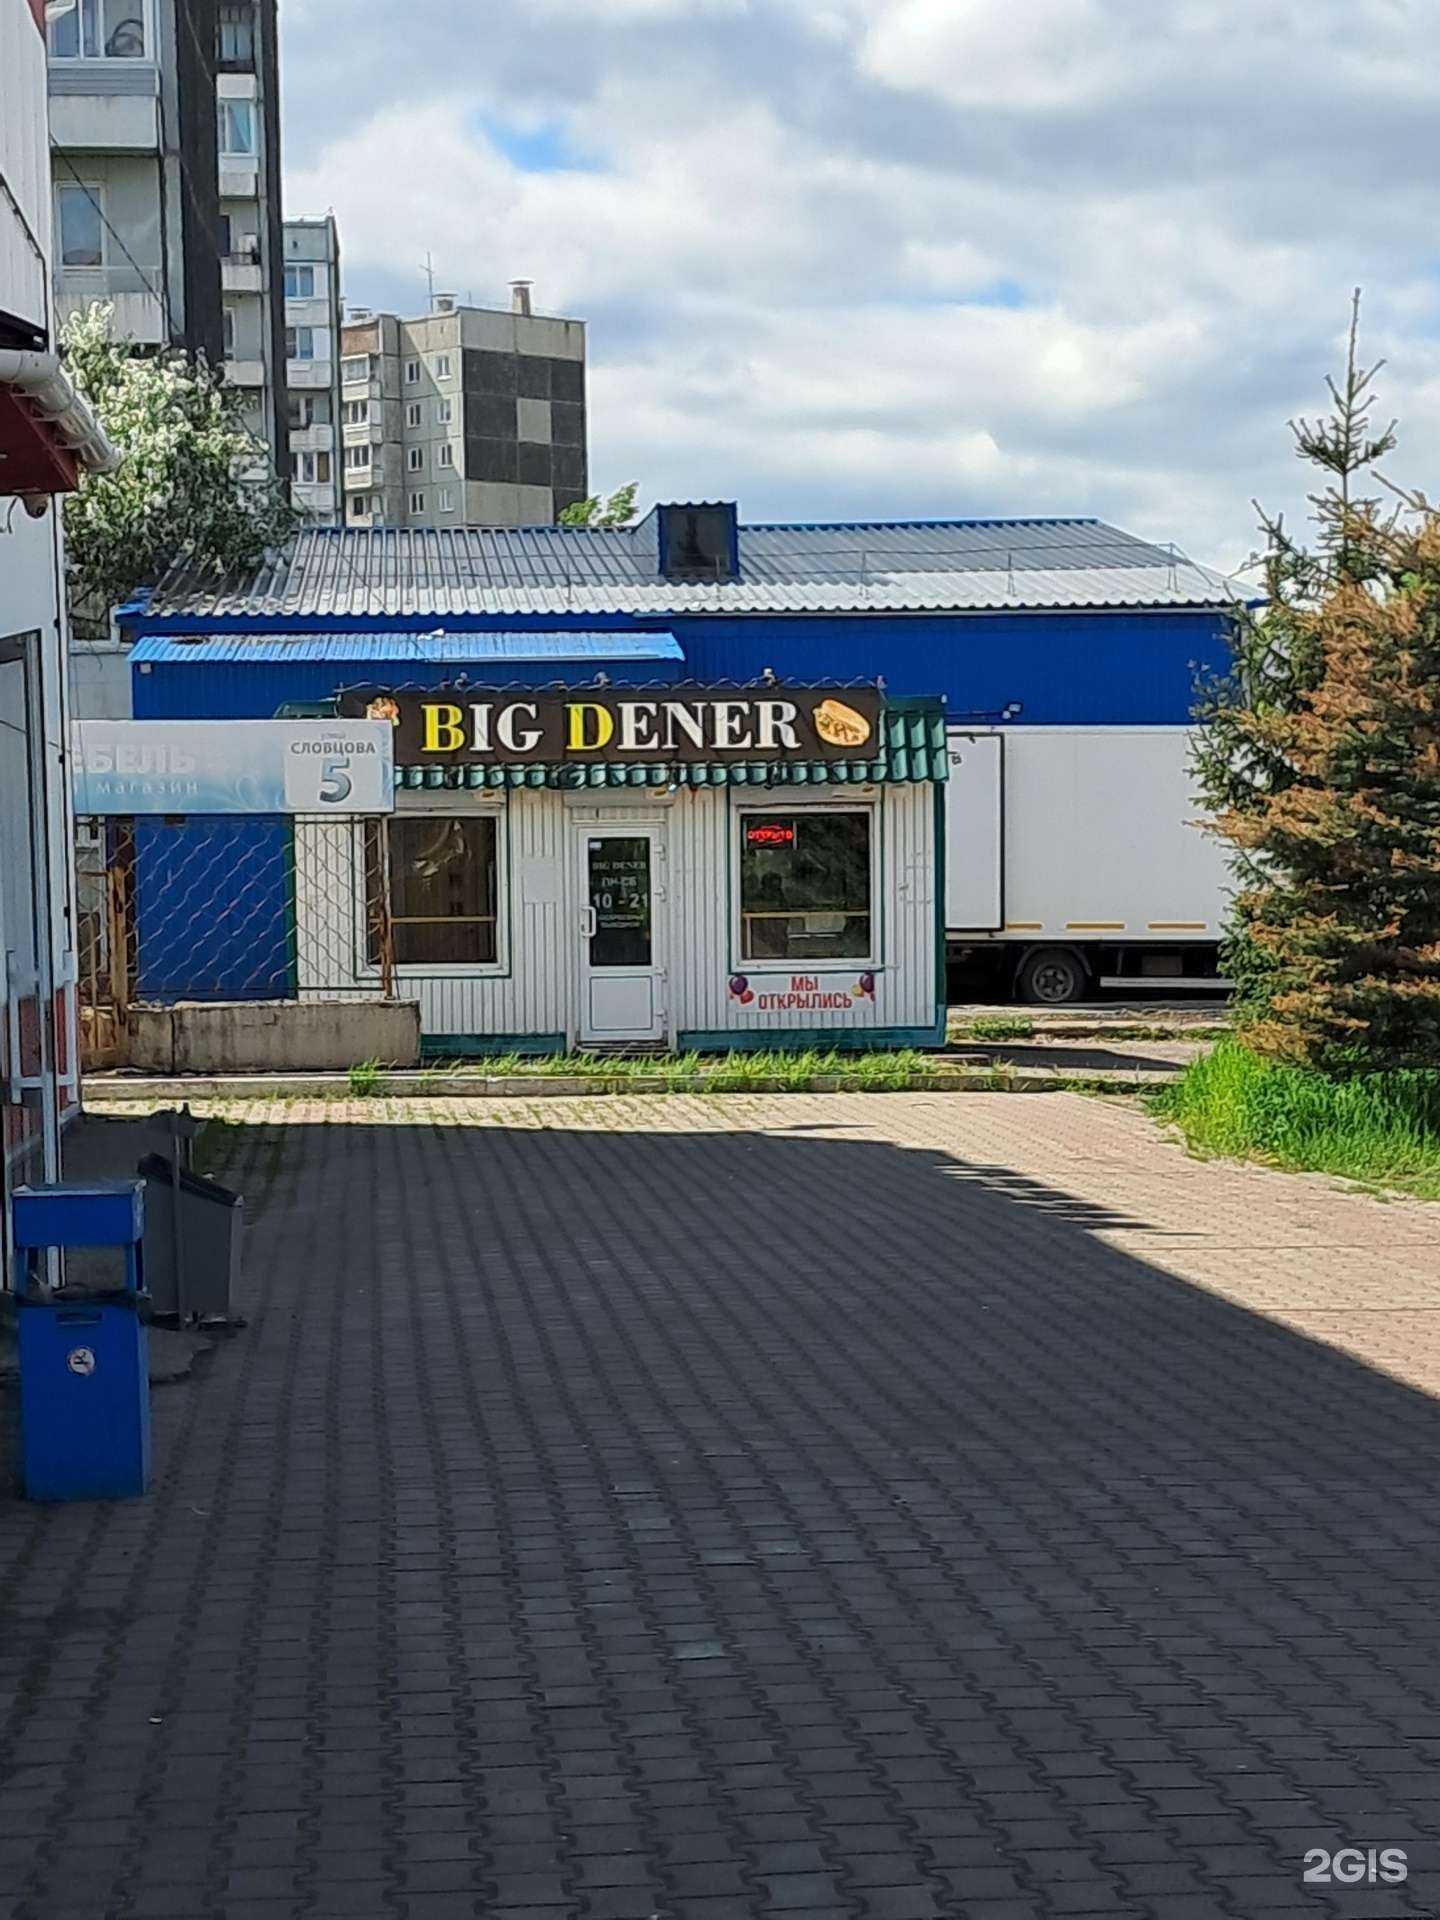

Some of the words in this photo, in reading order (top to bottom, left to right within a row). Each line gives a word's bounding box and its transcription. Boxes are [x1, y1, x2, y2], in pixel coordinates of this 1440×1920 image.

[421, 702, 543, 752] BIG
[565, 702, 801, 751] DENER
[290, 741, 376, 756] СЛОВЦОВА
[96, 781, 200, 795] магазин
[319, 757, 352, 803] 5
[593, 892, 613, 909] 10
[629, 892, 648, 909] 21
[790, 975, 819, 992] МЫ
[758, 992, 853, 1010] ОТКРЫЛИСЬ
